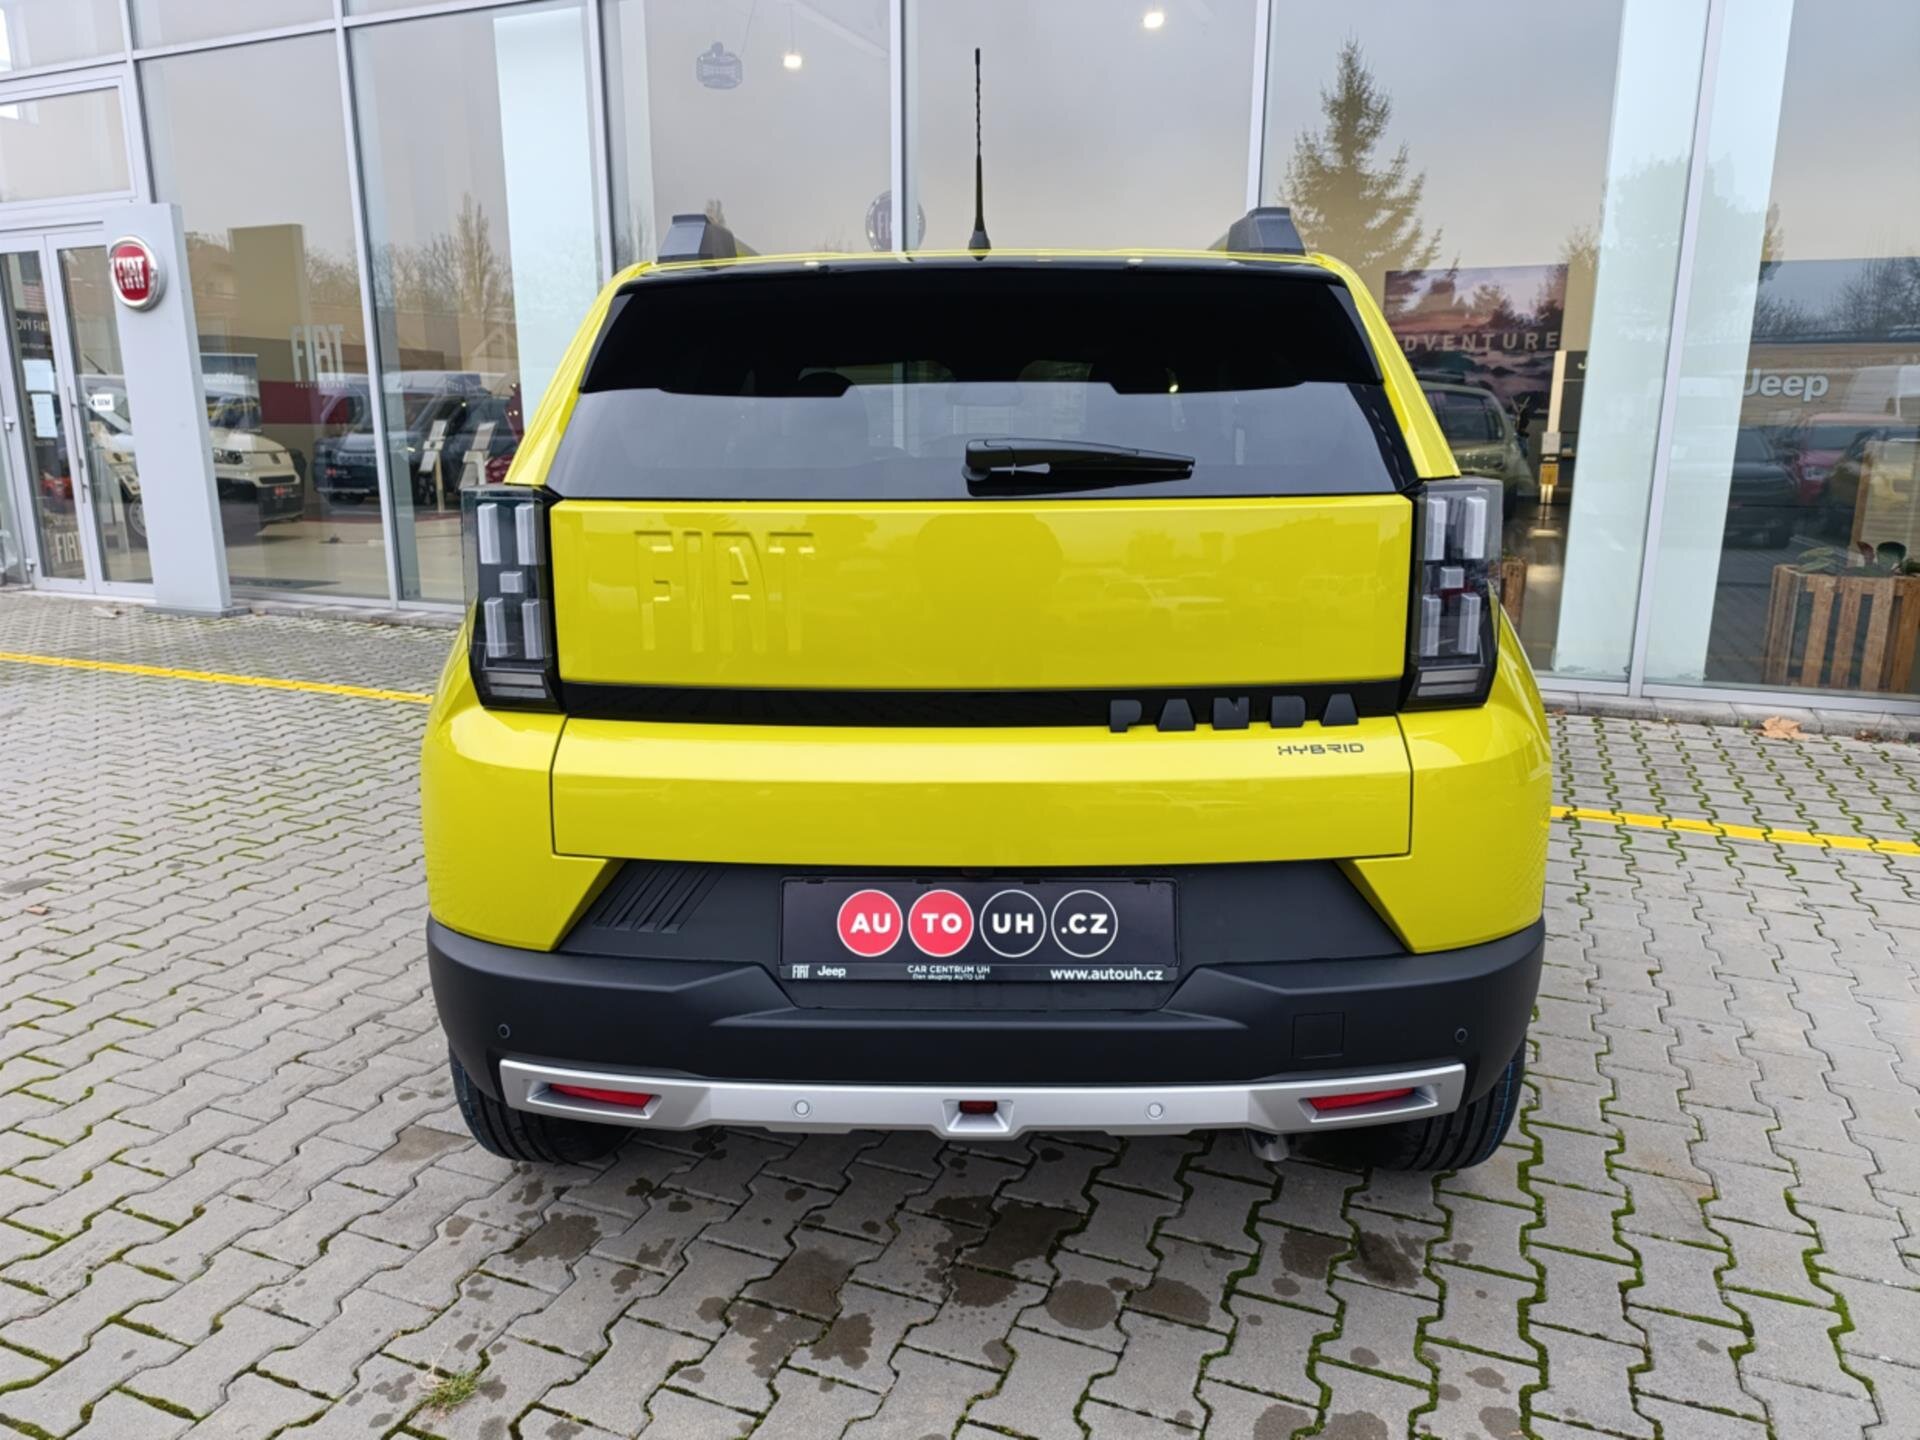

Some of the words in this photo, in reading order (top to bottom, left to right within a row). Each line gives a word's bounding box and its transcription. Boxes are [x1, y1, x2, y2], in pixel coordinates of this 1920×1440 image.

[114, 255, 145, 290] FIAT
[1404, 331, 1559, 352] DVENTURE
[290, 324, 344, 382] FIAT
[1744, 367, 1829, 402] Jeep
[634, 530, 816, 654] FIAT
[1109, 693, 1359, 733] PANDA
[1277, 743, 1365, 756] HYBRID
[1060, 913, 1109, 935] .CZ
[792, 965, 810, 979] FIAT
[817, 965, 847, 979] Jeep
[907, 965, 927, 974] CAR
[930, 965, 975, 974] CENTRUM
[977, 965, 991, 974] UH
[1050, 967, 1163, 981] www.autouh.cz
